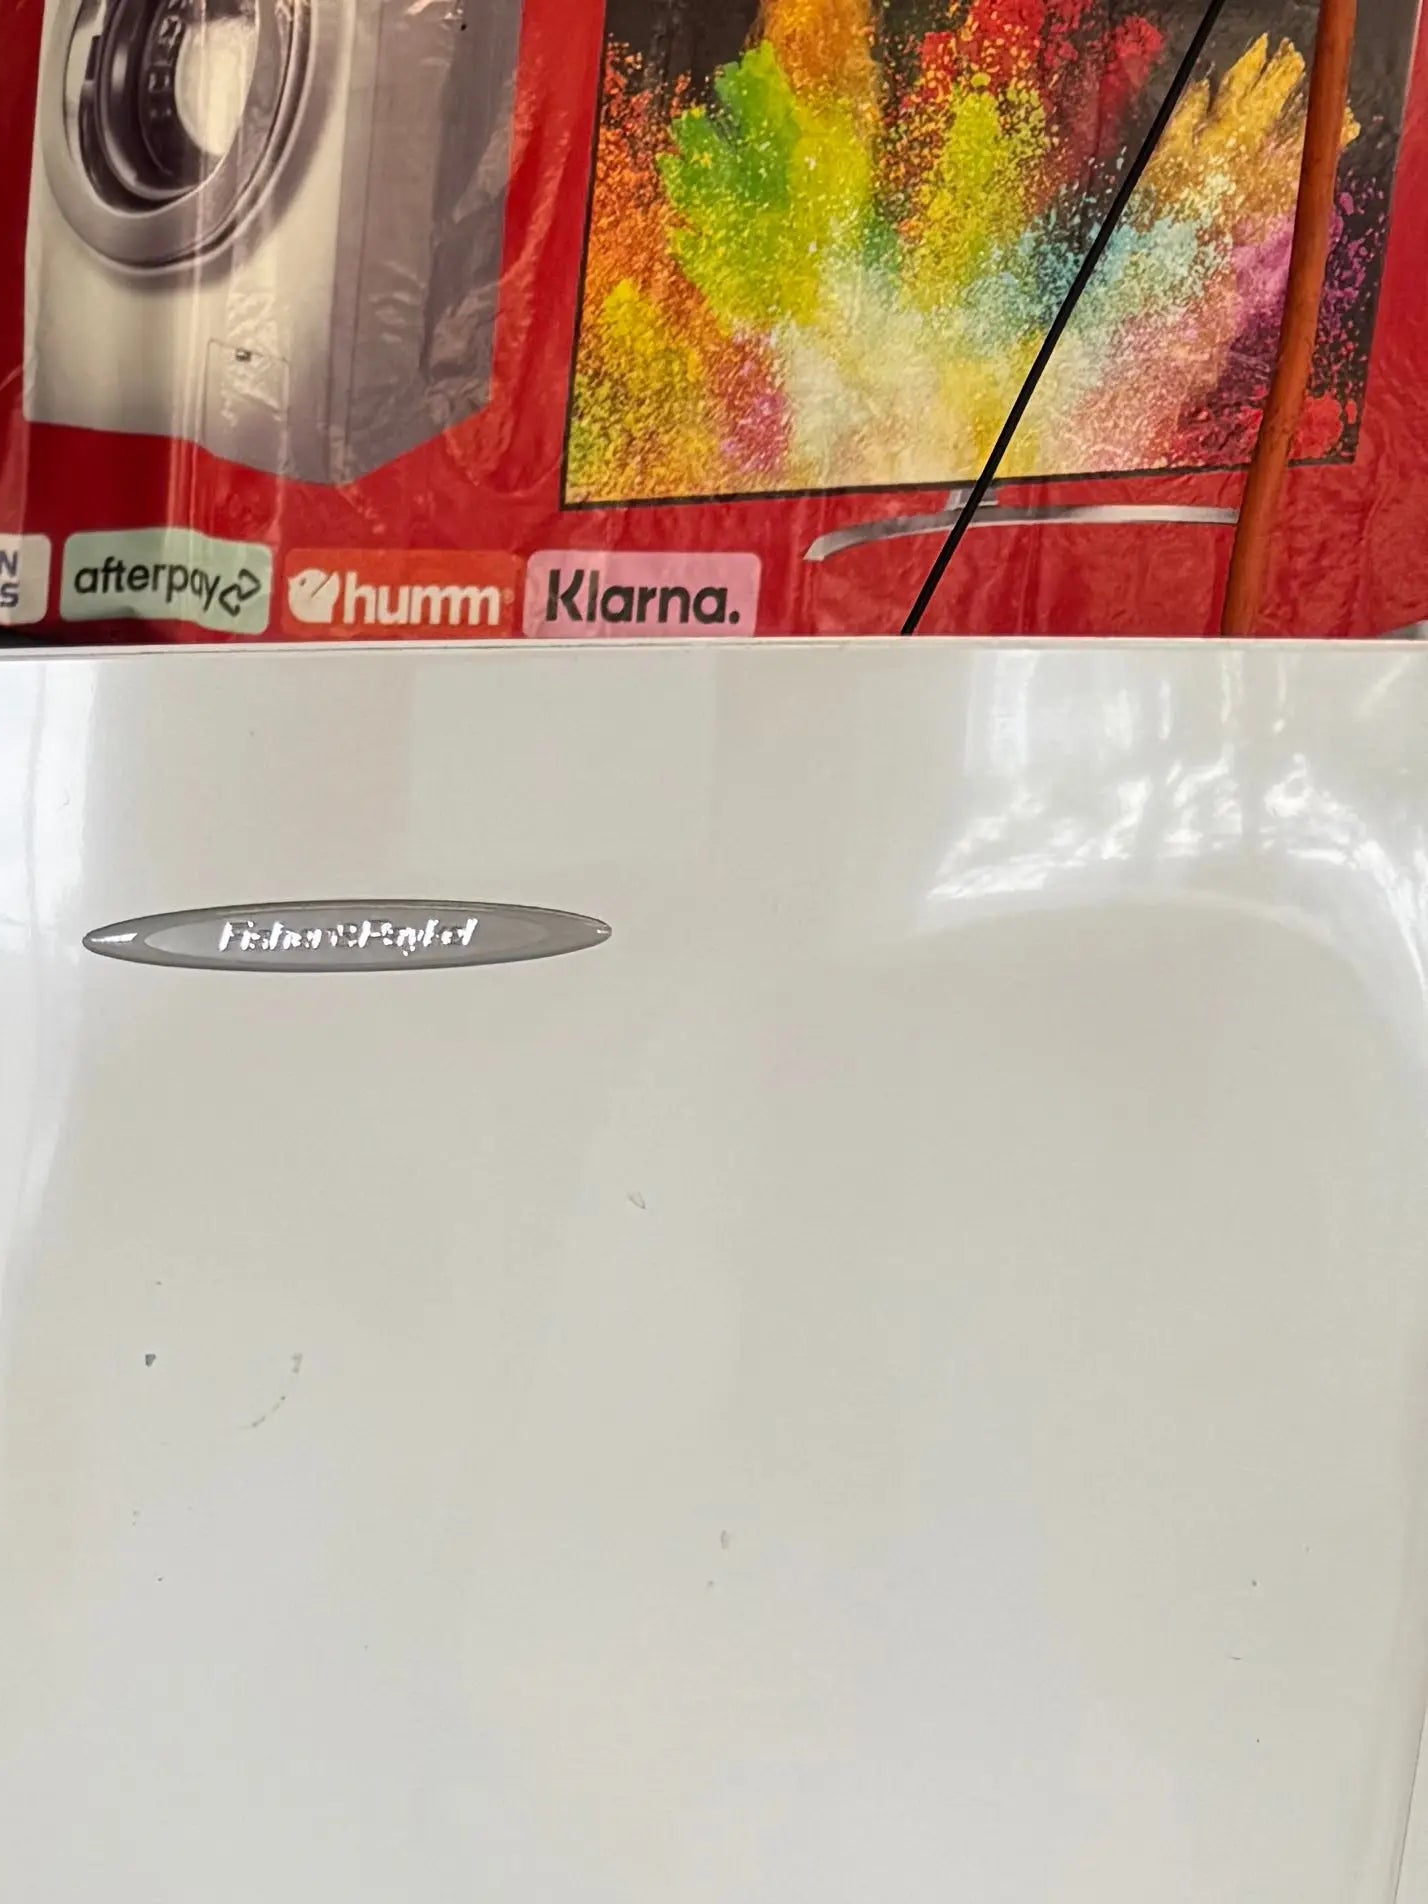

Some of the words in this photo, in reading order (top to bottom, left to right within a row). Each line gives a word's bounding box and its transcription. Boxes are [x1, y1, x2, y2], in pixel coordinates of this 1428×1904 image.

[74, 556, 222, 612] afterpay
[343, 571, 500, 626] humm
[545, 569, 740, 625] Klarna.
